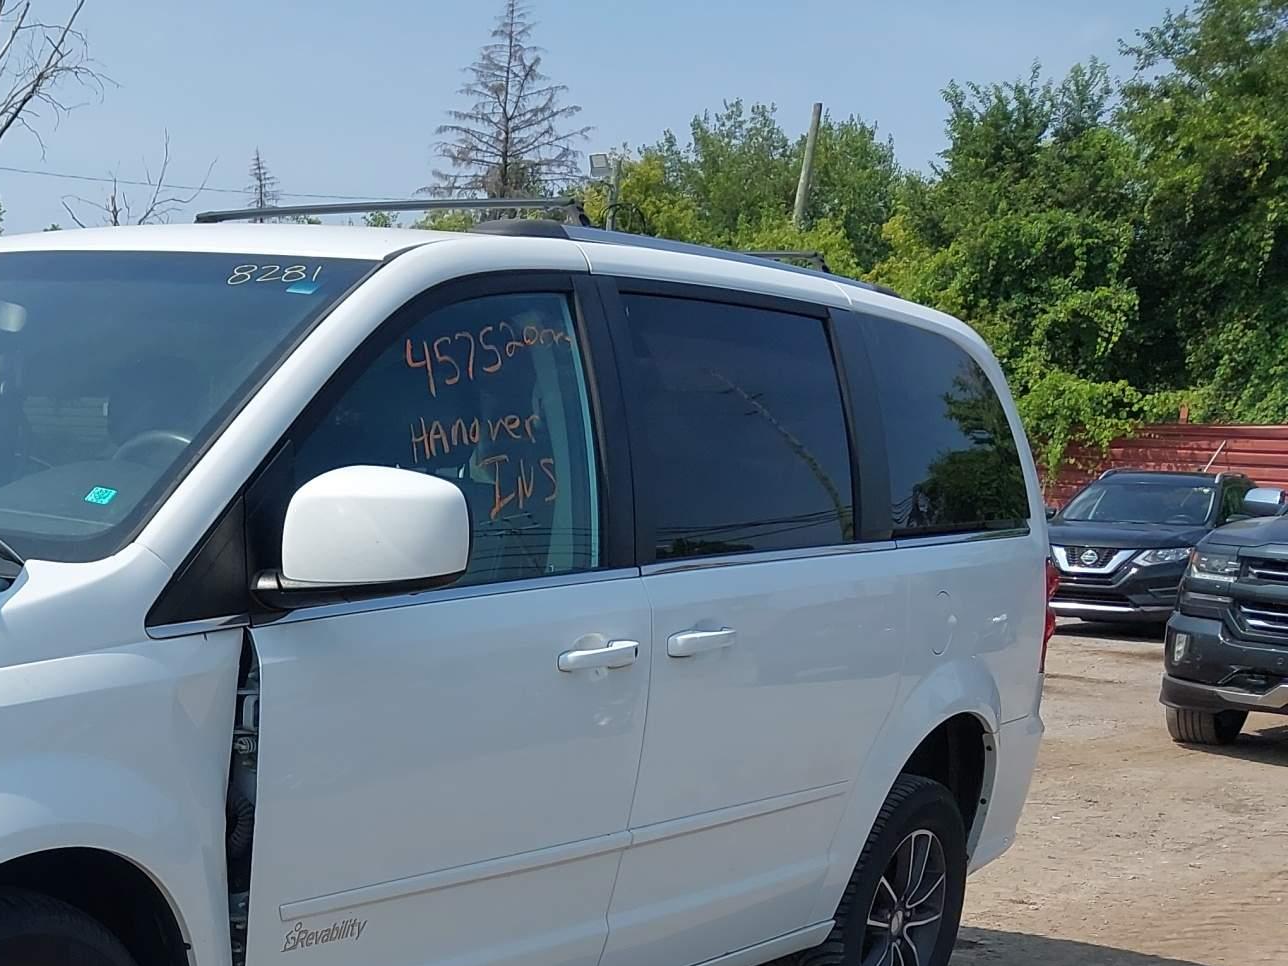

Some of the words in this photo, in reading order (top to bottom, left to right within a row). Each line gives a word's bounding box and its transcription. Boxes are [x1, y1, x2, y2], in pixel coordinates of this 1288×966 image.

[227, 264, 322, 285] 8281
[478, 454, 558, 520] INS
[296, 918, 369, 949] Revability
